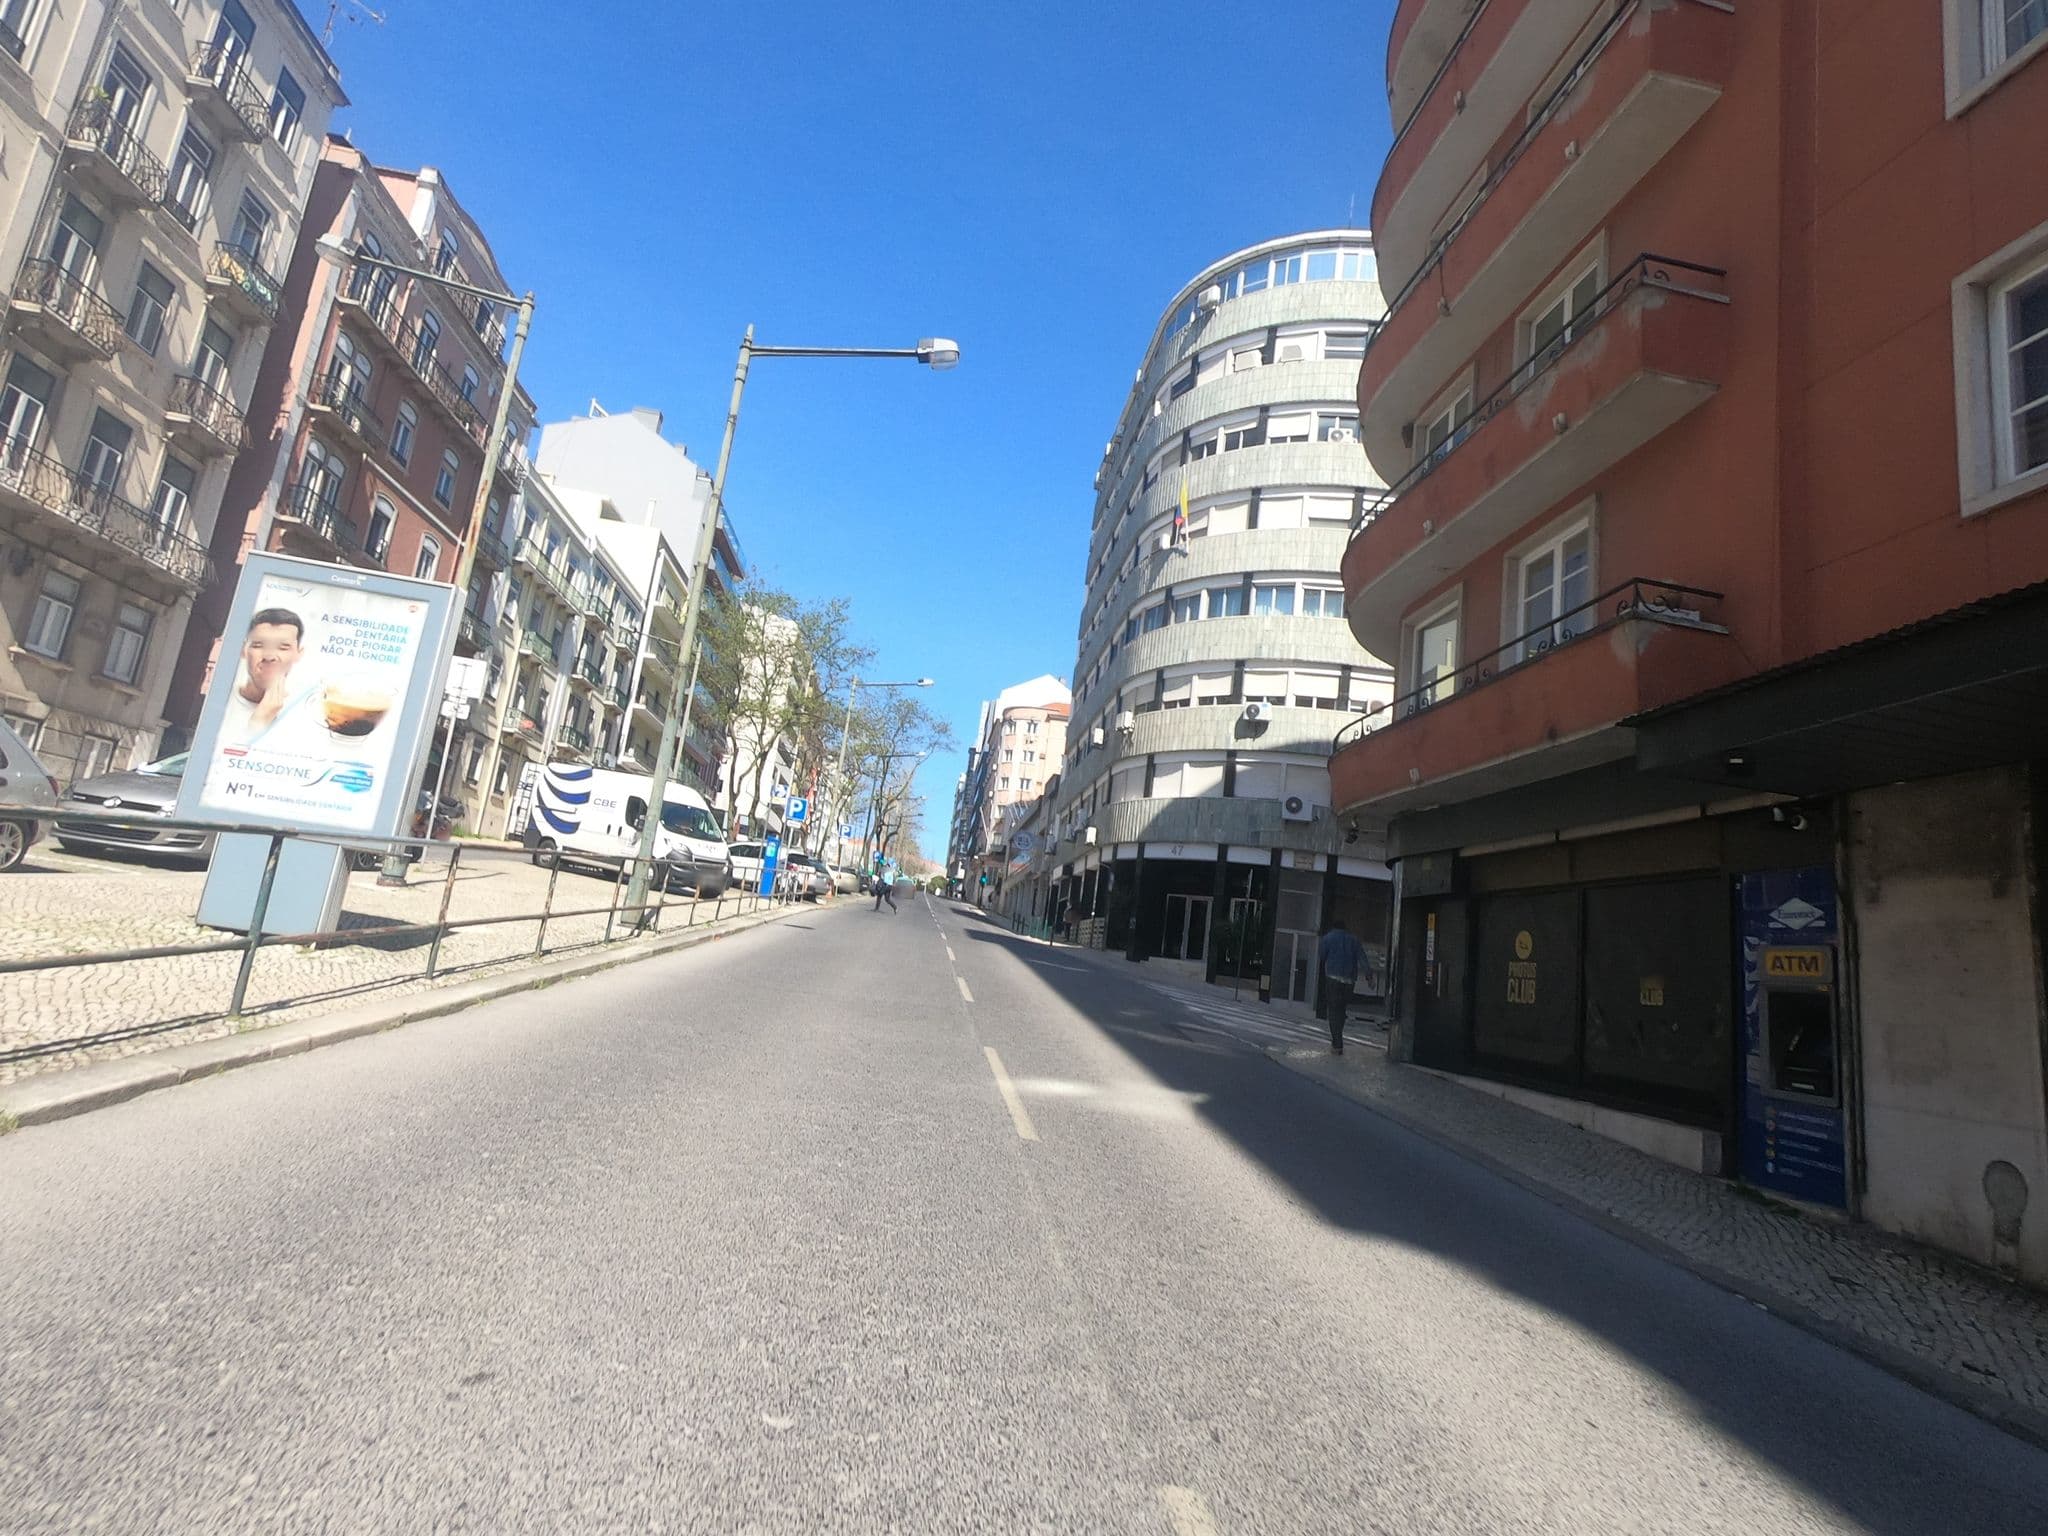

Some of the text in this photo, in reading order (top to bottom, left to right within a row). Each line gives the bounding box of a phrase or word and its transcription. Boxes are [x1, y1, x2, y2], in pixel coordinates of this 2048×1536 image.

[321, 613, 409, 634] A SENSIBILIDADE
[329, 635, 359, 647] PODE
[347, 649, 355, 657] A
[227, 758, 312, 779] SENSODYNE
[593, 797, 617, 809] CBE
[789, 798, 803, 817] P
[1771, 955, 1818, 972] ATM
[1507, 978, 1536, 1004] CLUB
